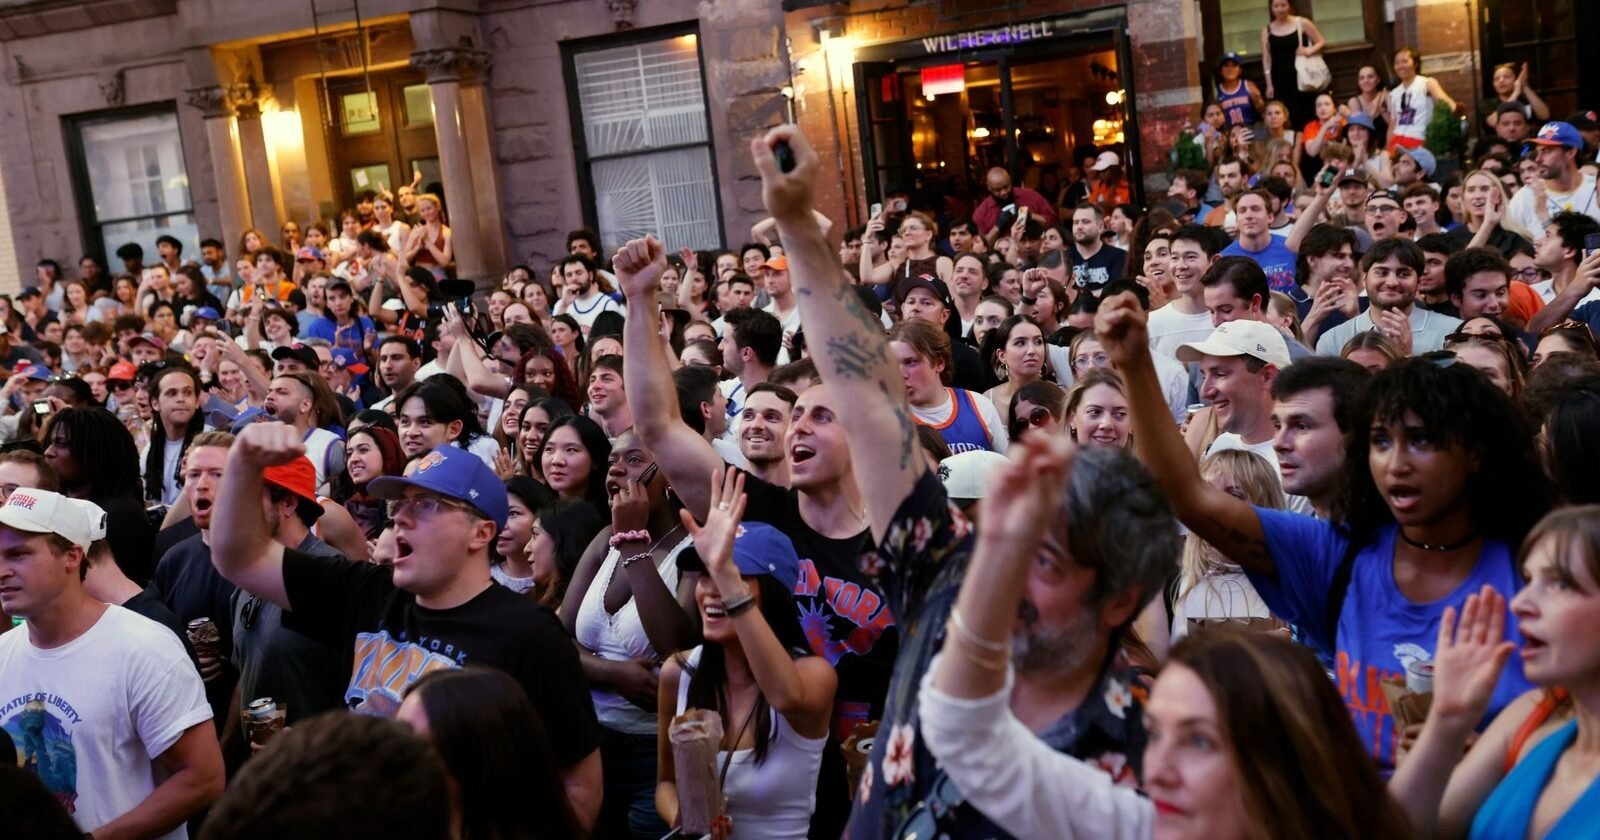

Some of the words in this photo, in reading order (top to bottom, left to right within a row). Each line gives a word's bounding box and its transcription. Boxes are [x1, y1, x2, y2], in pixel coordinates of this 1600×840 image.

[922, 31, 986, 53] WILFIE
[991, 33, 1002, 44] &
[1004, 21, 1053, 43] NELL
[418, 636, 468, 665] YORK
[35, 692, 47, 702] OF
[47, 694, 82, 724] LIBERTY
